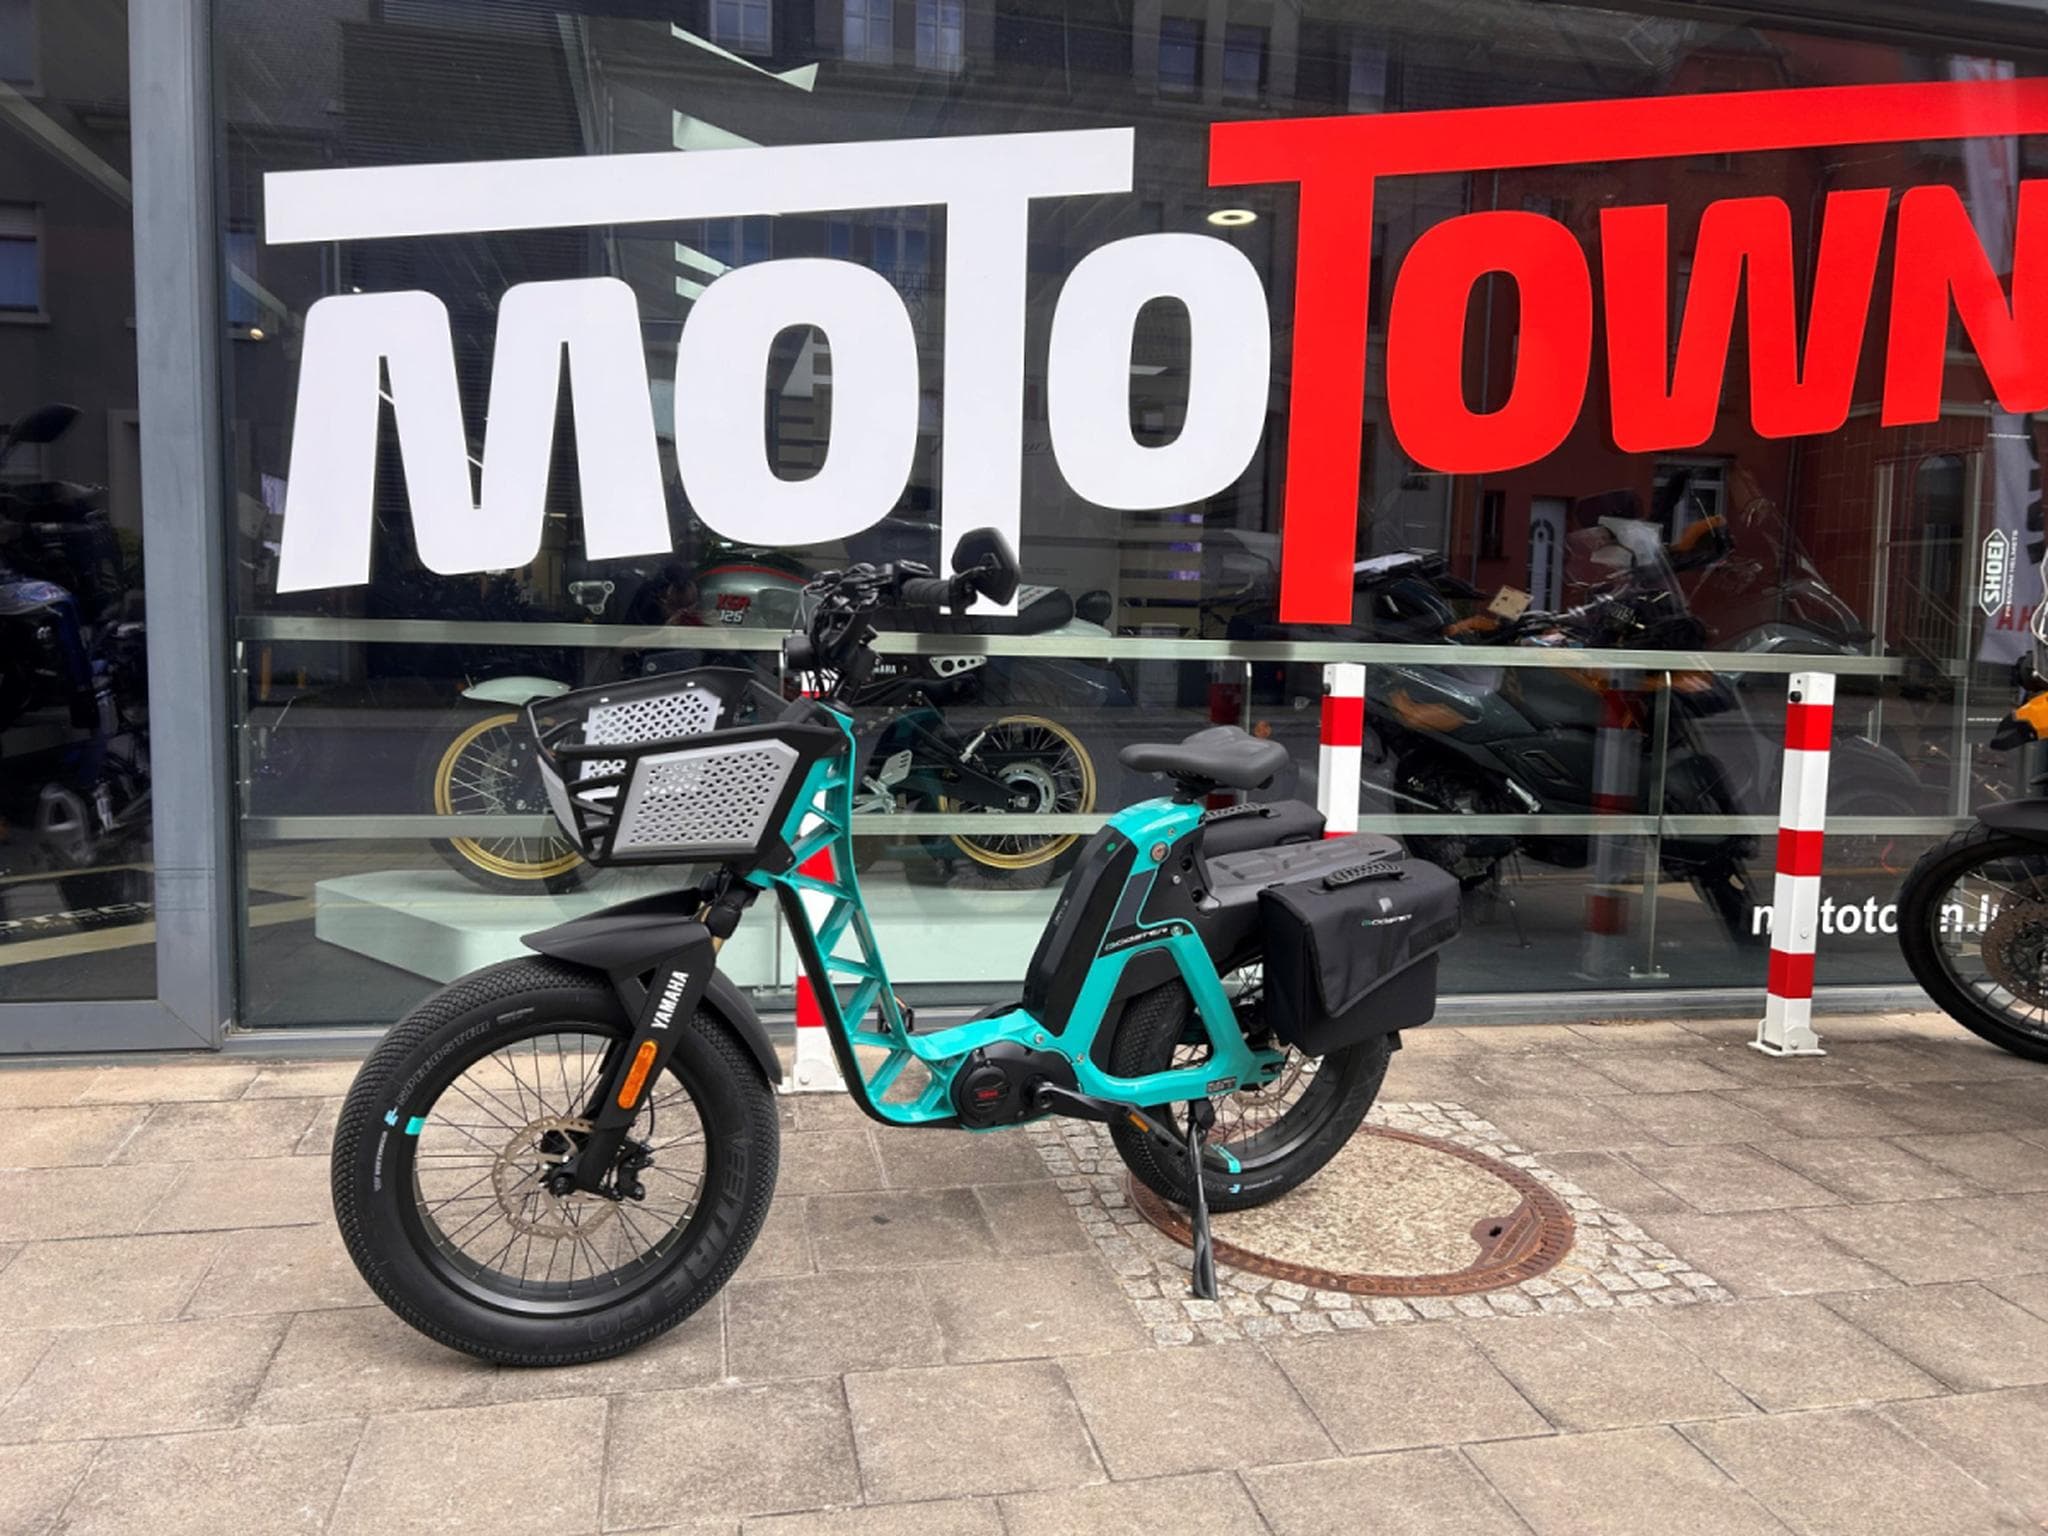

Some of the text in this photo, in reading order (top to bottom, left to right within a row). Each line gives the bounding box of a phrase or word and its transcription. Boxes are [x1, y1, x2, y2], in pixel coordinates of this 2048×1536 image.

[1984, 541, 2005, 605] SHOEI
[719, 609, 743, 624] 125
[650, 970, 690, 1030] YAMAHA
